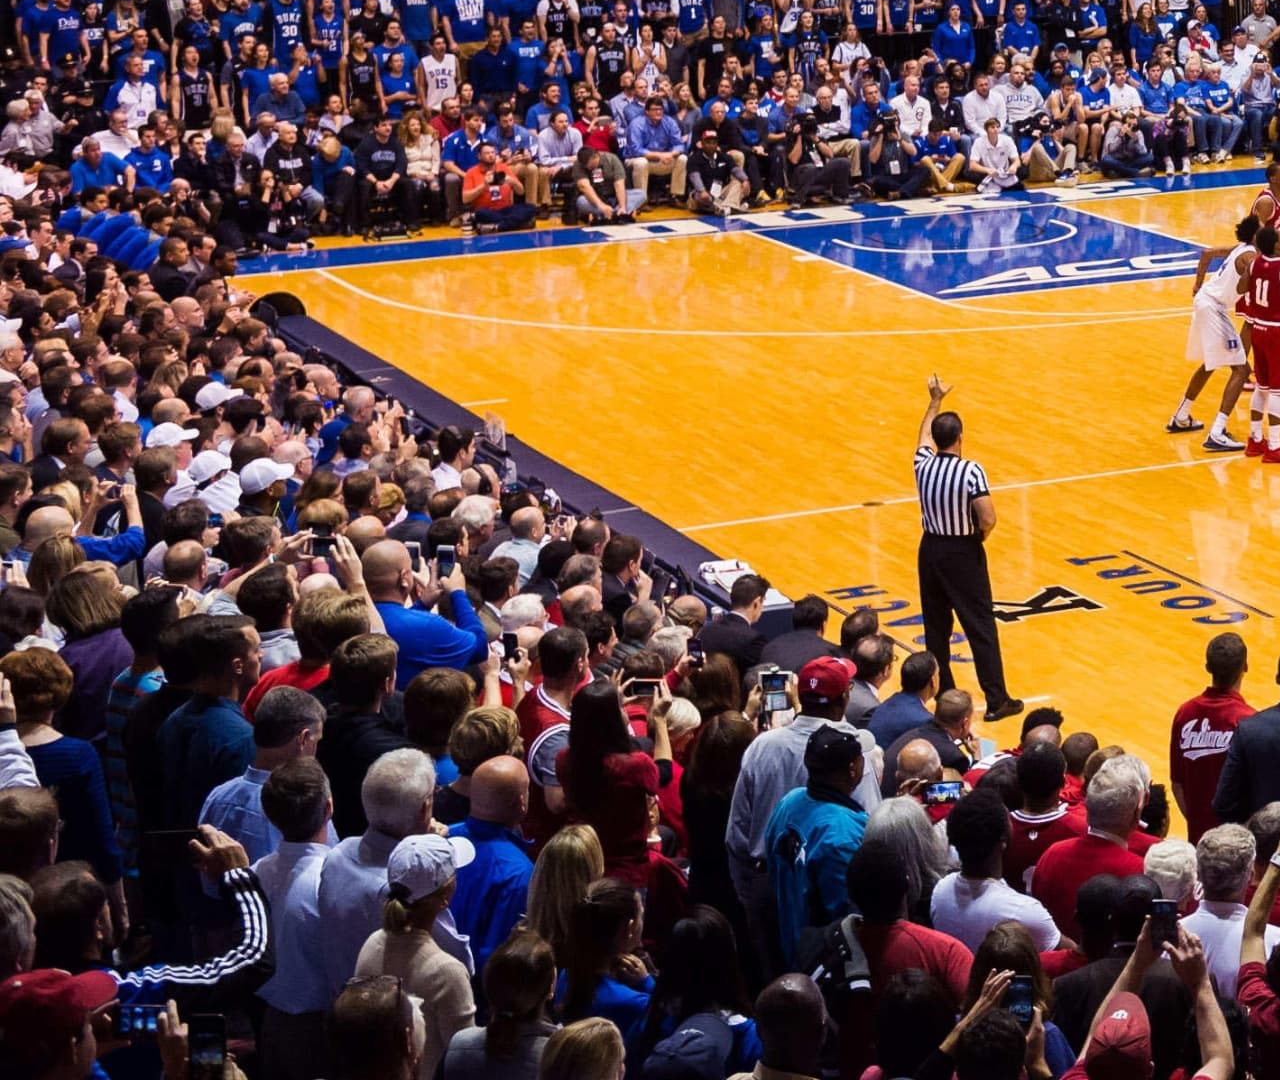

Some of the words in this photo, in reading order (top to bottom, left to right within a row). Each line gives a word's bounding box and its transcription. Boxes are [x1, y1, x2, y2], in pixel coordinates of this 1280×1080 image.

[860, 4, 874, 15] 30
[276, 12, 301, 24] DUKE
[282, 26, 298, 37] 30
[1066, 552, 1250, 626] COURT
